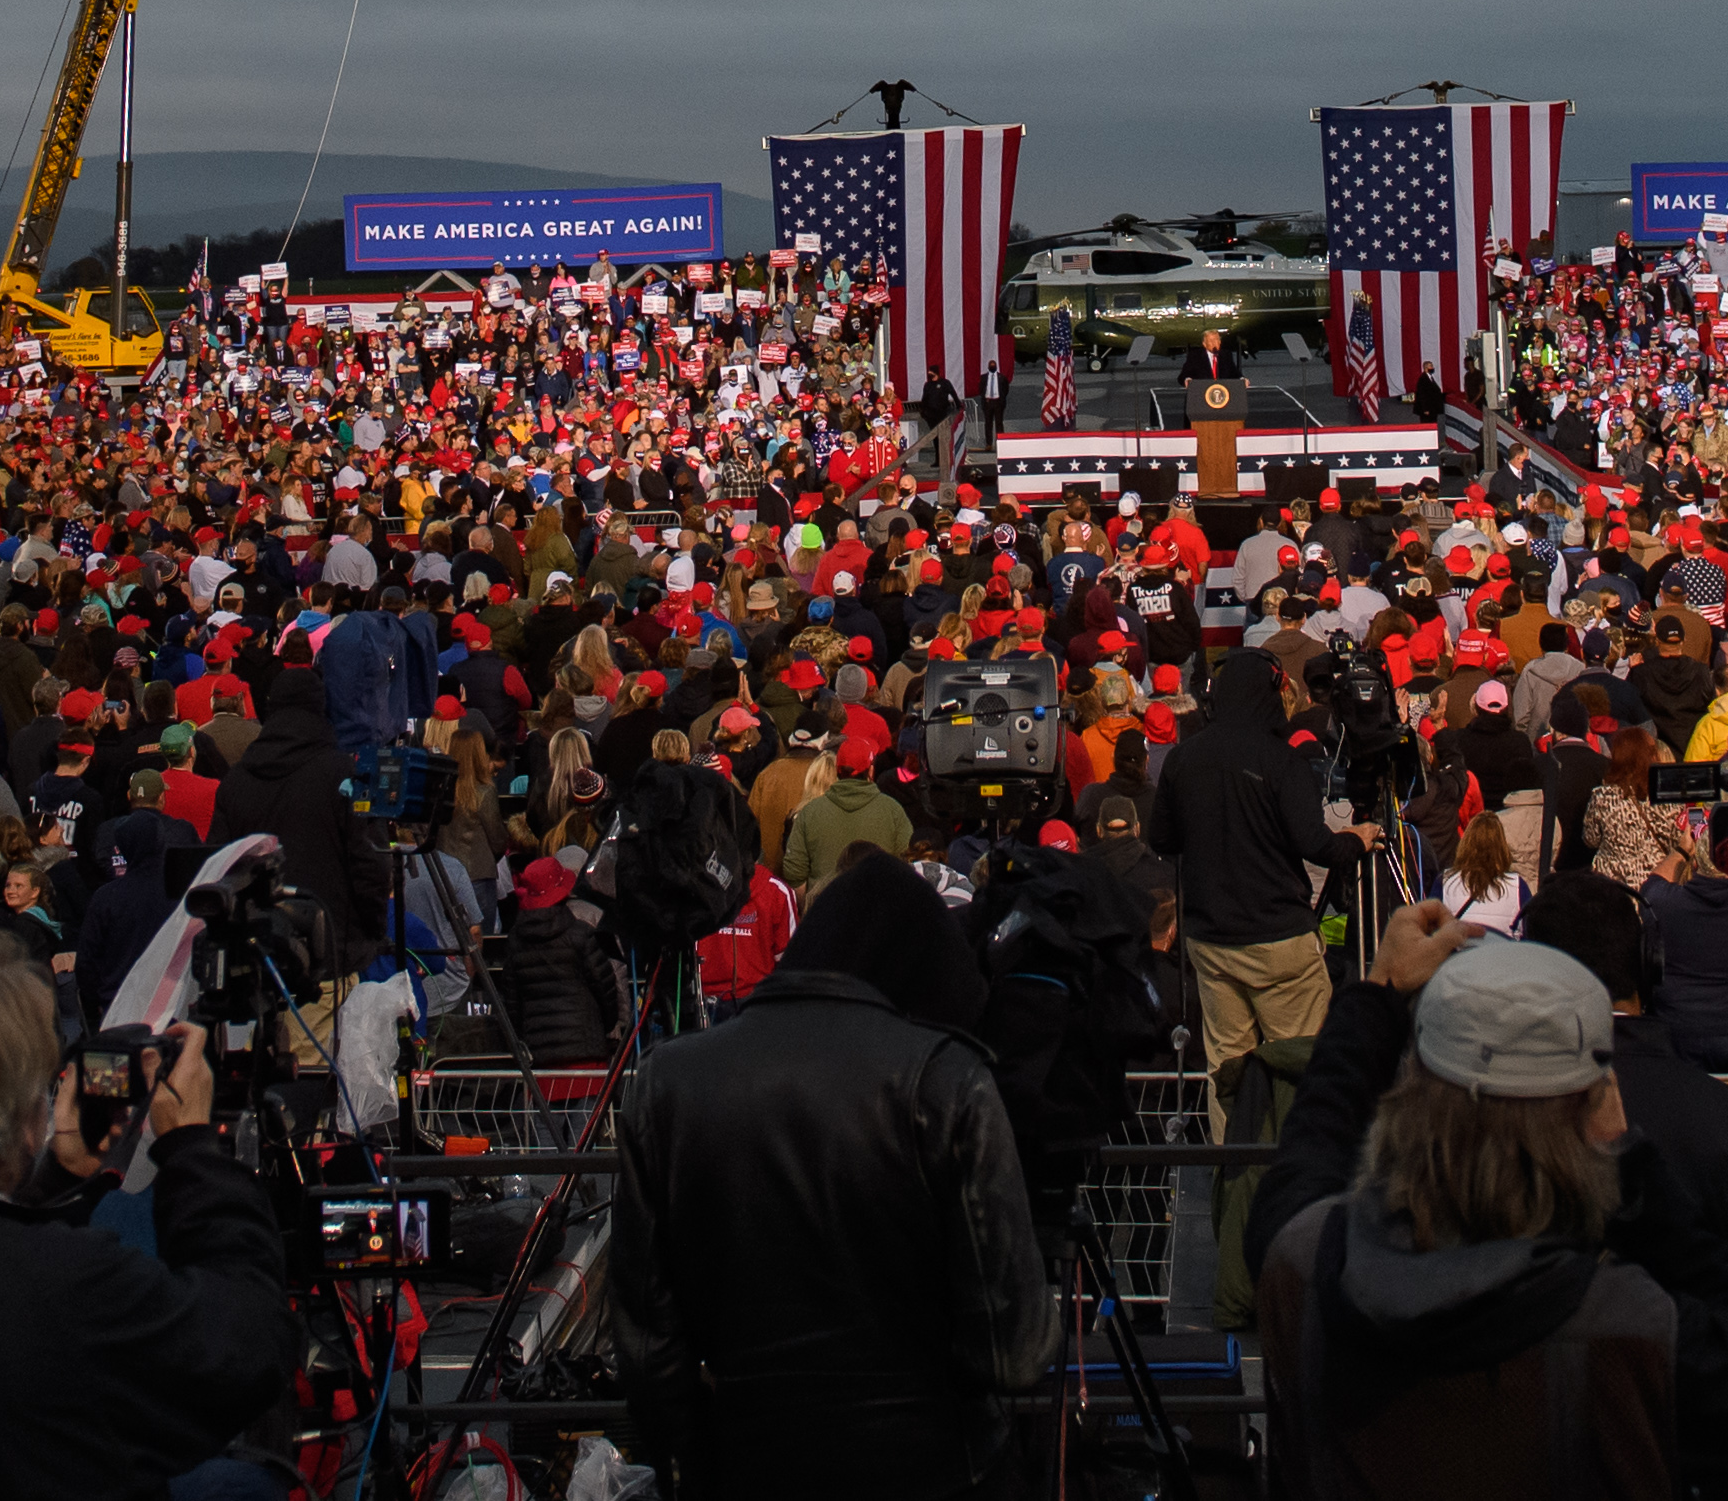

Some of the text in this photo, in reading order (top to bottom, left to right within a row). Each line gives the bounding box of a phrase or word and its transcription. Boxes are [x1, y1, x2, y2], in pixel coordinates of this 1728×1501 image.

[1652, 194, 1717, 210] MAKE
[364, 215, 703, 240] MAKE AMERICA GREAT AGAIN!
[1252, 288, 1293, 298] UNITED
[1131, 583, 1173, 598] TRUMP
[1136, 595, 1172, 616] 2020
[29, 796, 84, 820] TMP
